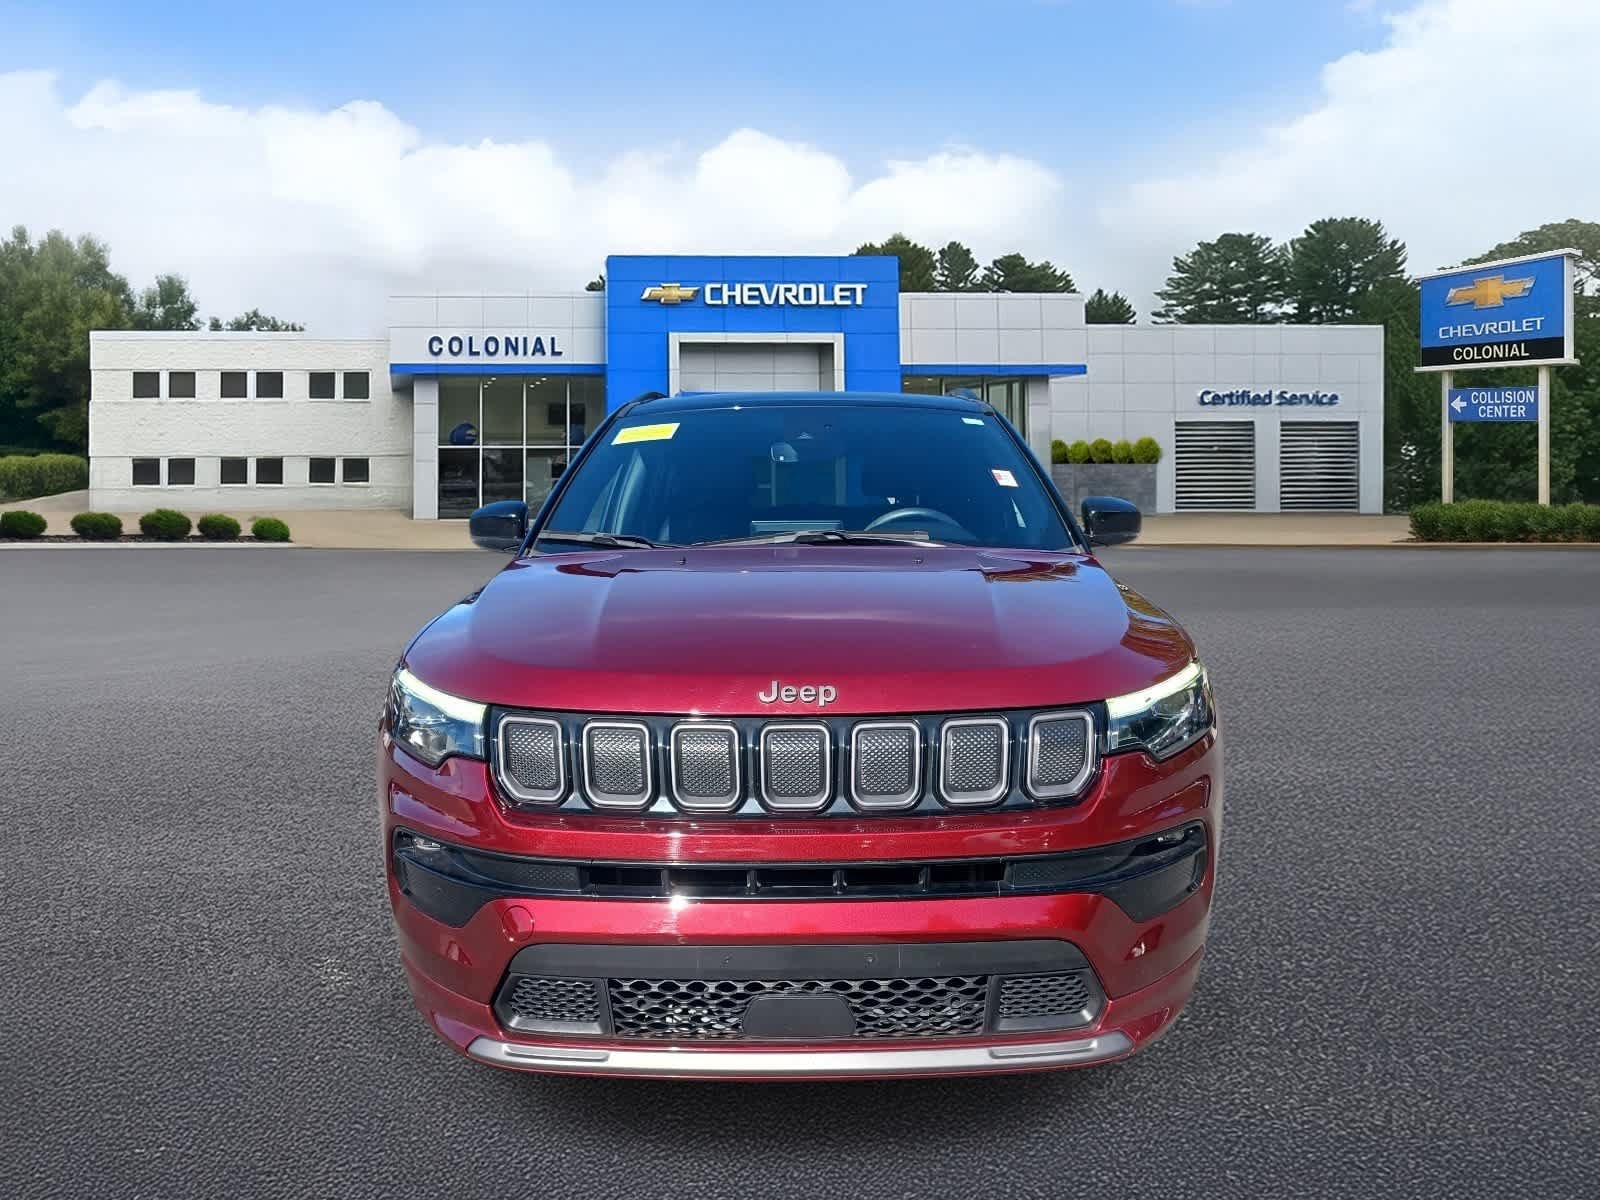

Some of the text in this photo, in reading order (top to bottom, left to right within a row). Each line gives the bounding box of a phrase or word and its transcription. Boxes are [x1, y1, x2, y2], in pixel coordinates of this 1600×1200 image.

[704, 283, 867, 306] CHEVROLET
[1438, 317, 1545, 339] CHEVROLET
[428, 335, 563, 357] COLONIAL
[1452, 343, 1530, 361] COLONIAL
[1199, 390, 1339, 406] Certified Service
[1471, 390, 1535, 404] COLLISION
[1478, 405, 1526, 418] CENTER
[758, 680, 837, 707] Jeep
